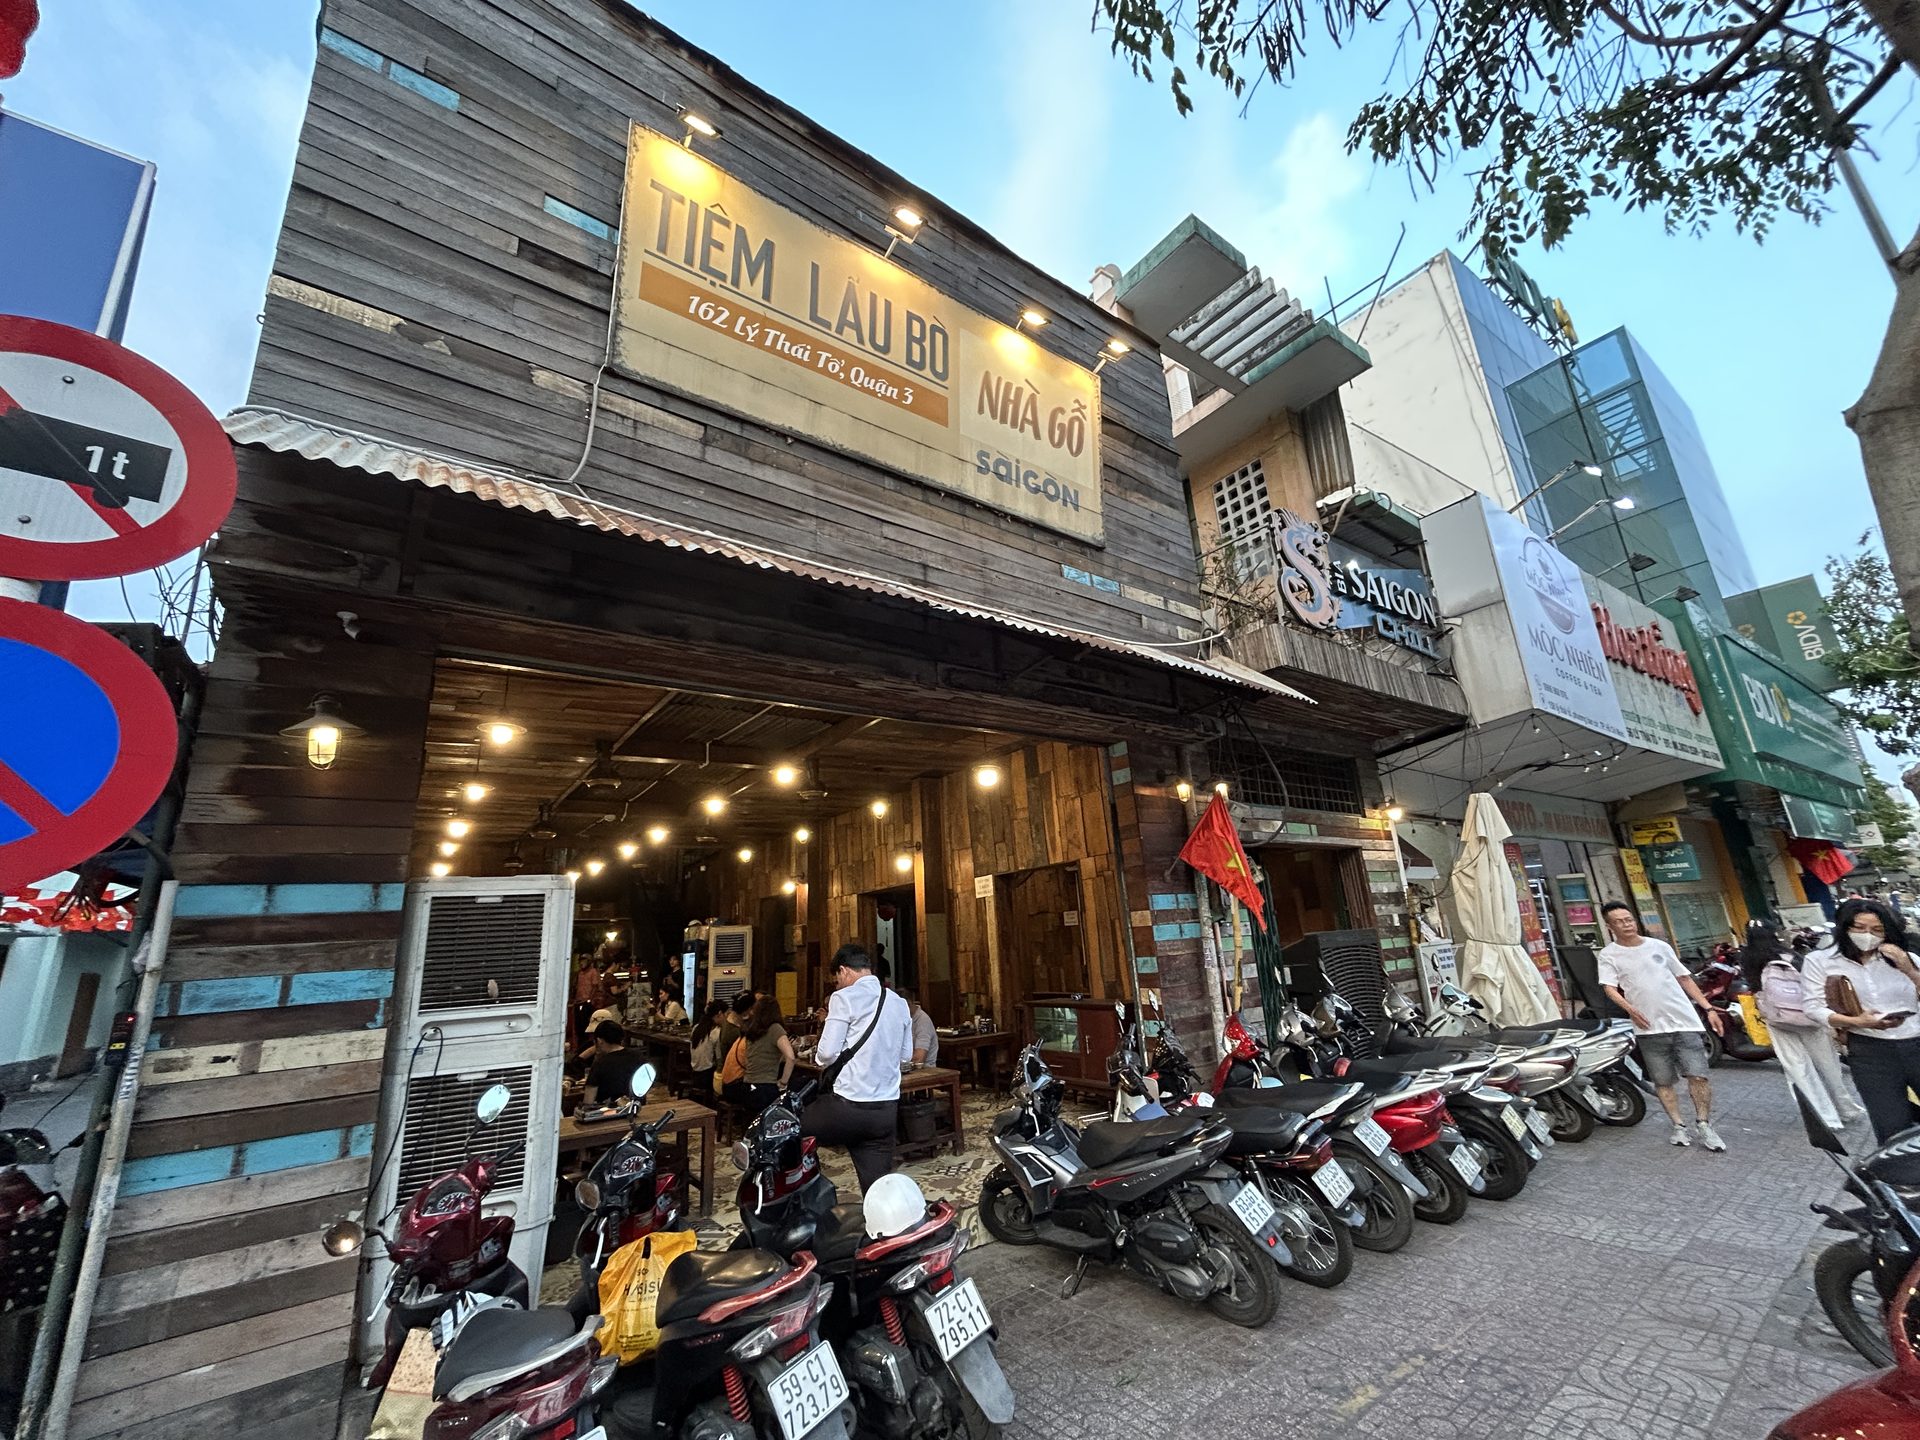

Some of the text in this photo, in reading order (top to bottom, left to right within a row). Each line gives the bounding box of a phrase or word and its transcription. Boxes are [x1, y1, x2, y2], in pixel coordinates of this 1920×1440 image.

[650, 178, 950, 382] TIỆM LẨU BÒ
[688, 295, 915, 406] 162 Lý Thái Tổ, Quận 3
[977, 370, 1088, 458] NHÀ GỖ
[1332, 560, 1348, 594] BIA
[1348, 566, 1438, 629] SAIGON
[1526, 622, 1565, 663] MỘC
[1794, 624, 1826, 661] BIDV
[934, 1287, 973, 1329] 72-C1
[939, 1305, 987, 1356] 795.11
[780, 1353, 826, 1404] 59-C1
[784, 1374, 843, 1438] 723.79
